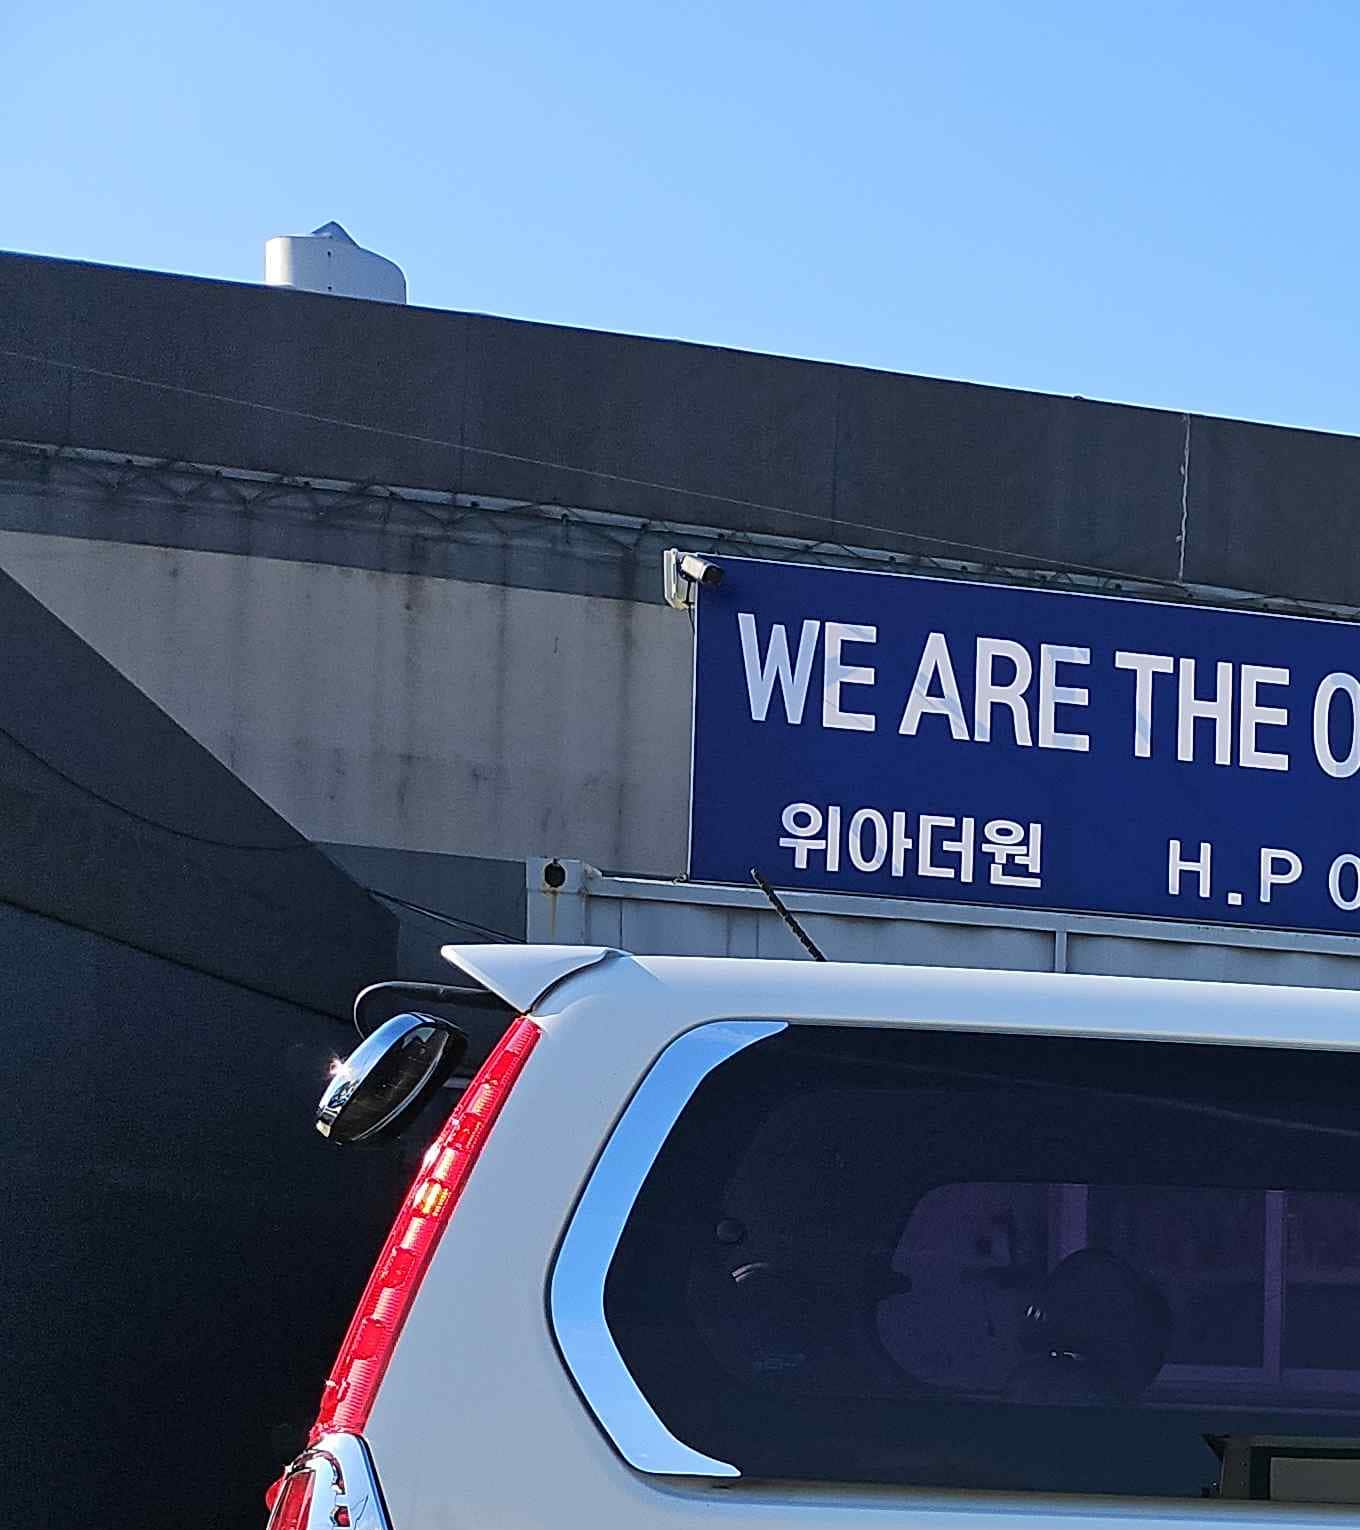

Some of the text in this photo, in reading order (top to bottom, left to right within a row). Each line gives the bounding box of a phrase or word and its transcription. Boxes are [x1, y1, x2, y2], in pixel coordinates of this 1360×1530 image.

[737, 612, 877, 732] WE
[898, 631, 1091, 752] ARE
[1114, 650, 1290, 771] THE
[779, 802, 1042, 888] 위아더원
